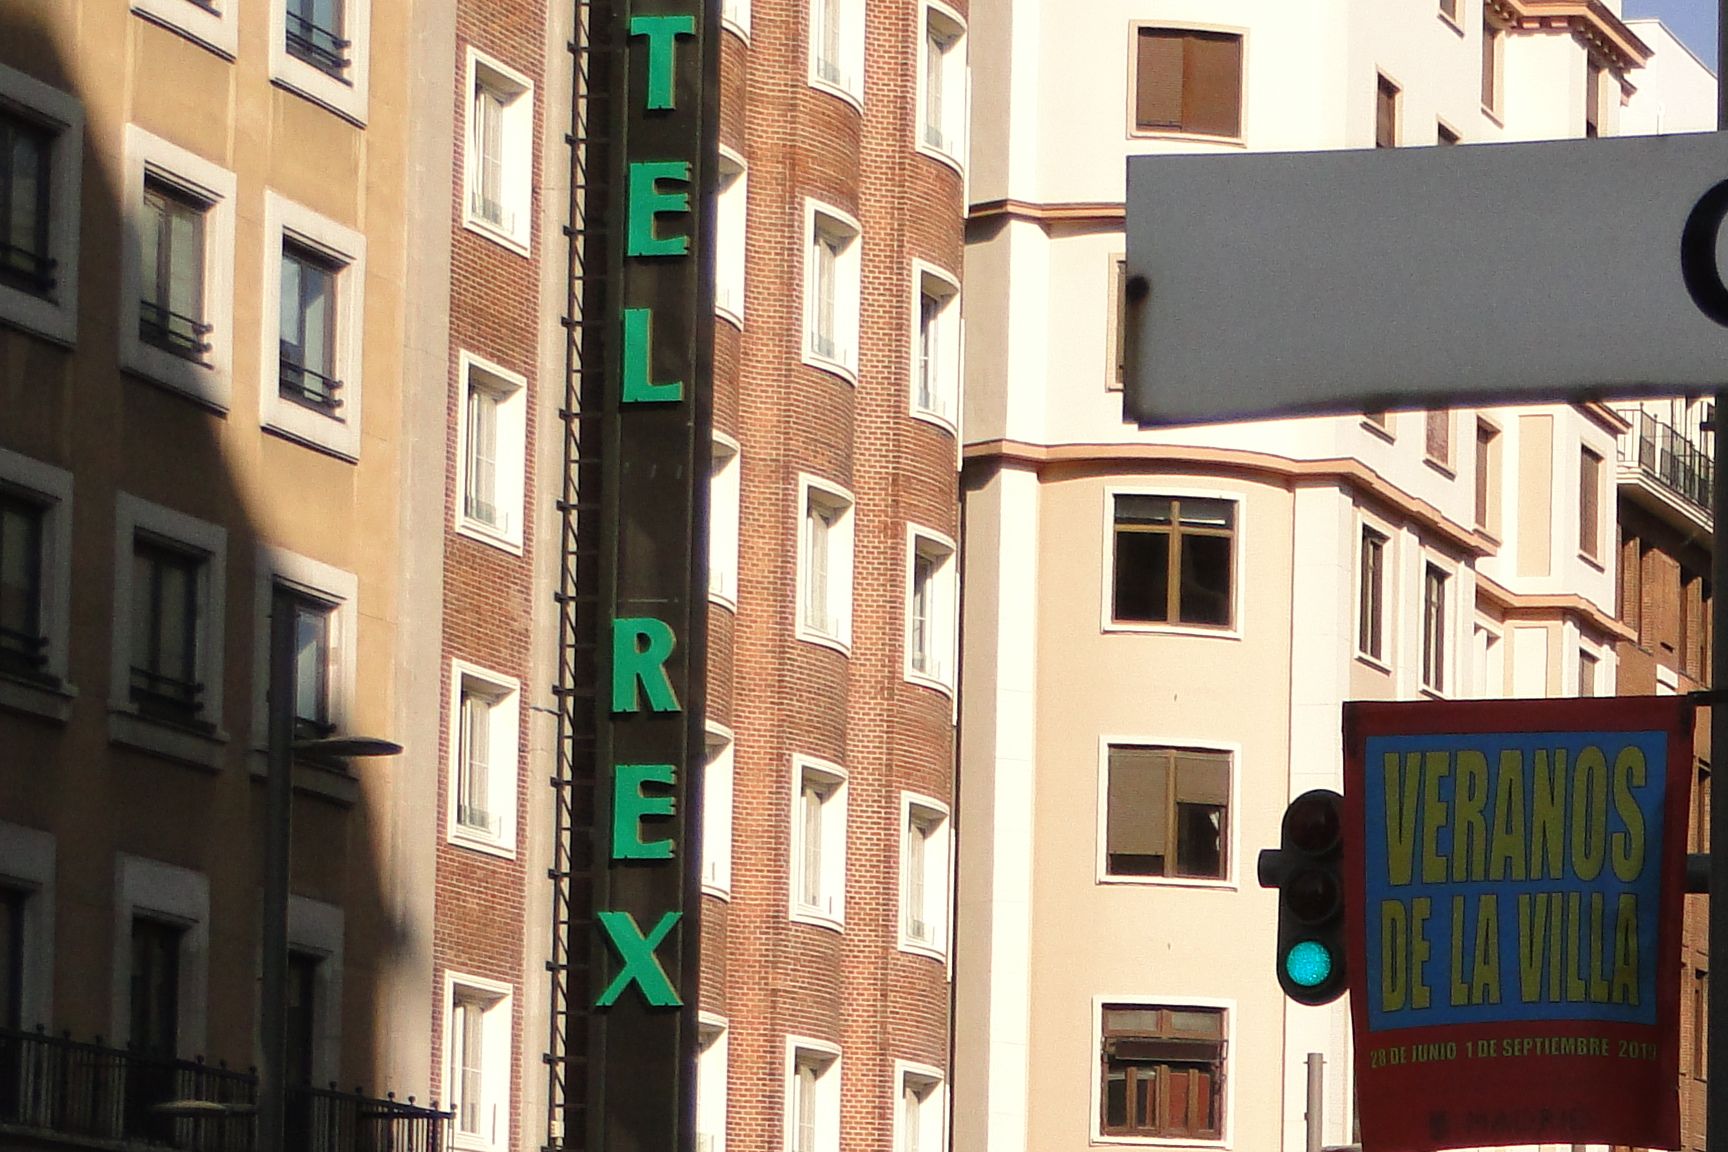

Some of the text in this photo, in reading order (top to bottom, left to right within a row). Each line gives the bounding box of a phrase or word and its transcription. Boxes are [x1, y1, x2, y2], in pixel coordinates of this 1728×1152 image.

[1382, 744, 1649, 888] VERANOS
[1380, 891, 1642, 1014] DE LA VILLA
[1370, 1048, 1390, 1068] 28
[1390, 1047, 1408, 1066] DE
[1411, 1041, 1457, 1064] JUNIO
[1466, 1042, 1475, 1059] 1
[1478, 1041, 1498, 1058] DE
[1502, 1036, 1611, 1059] SEPTIEMBRE
